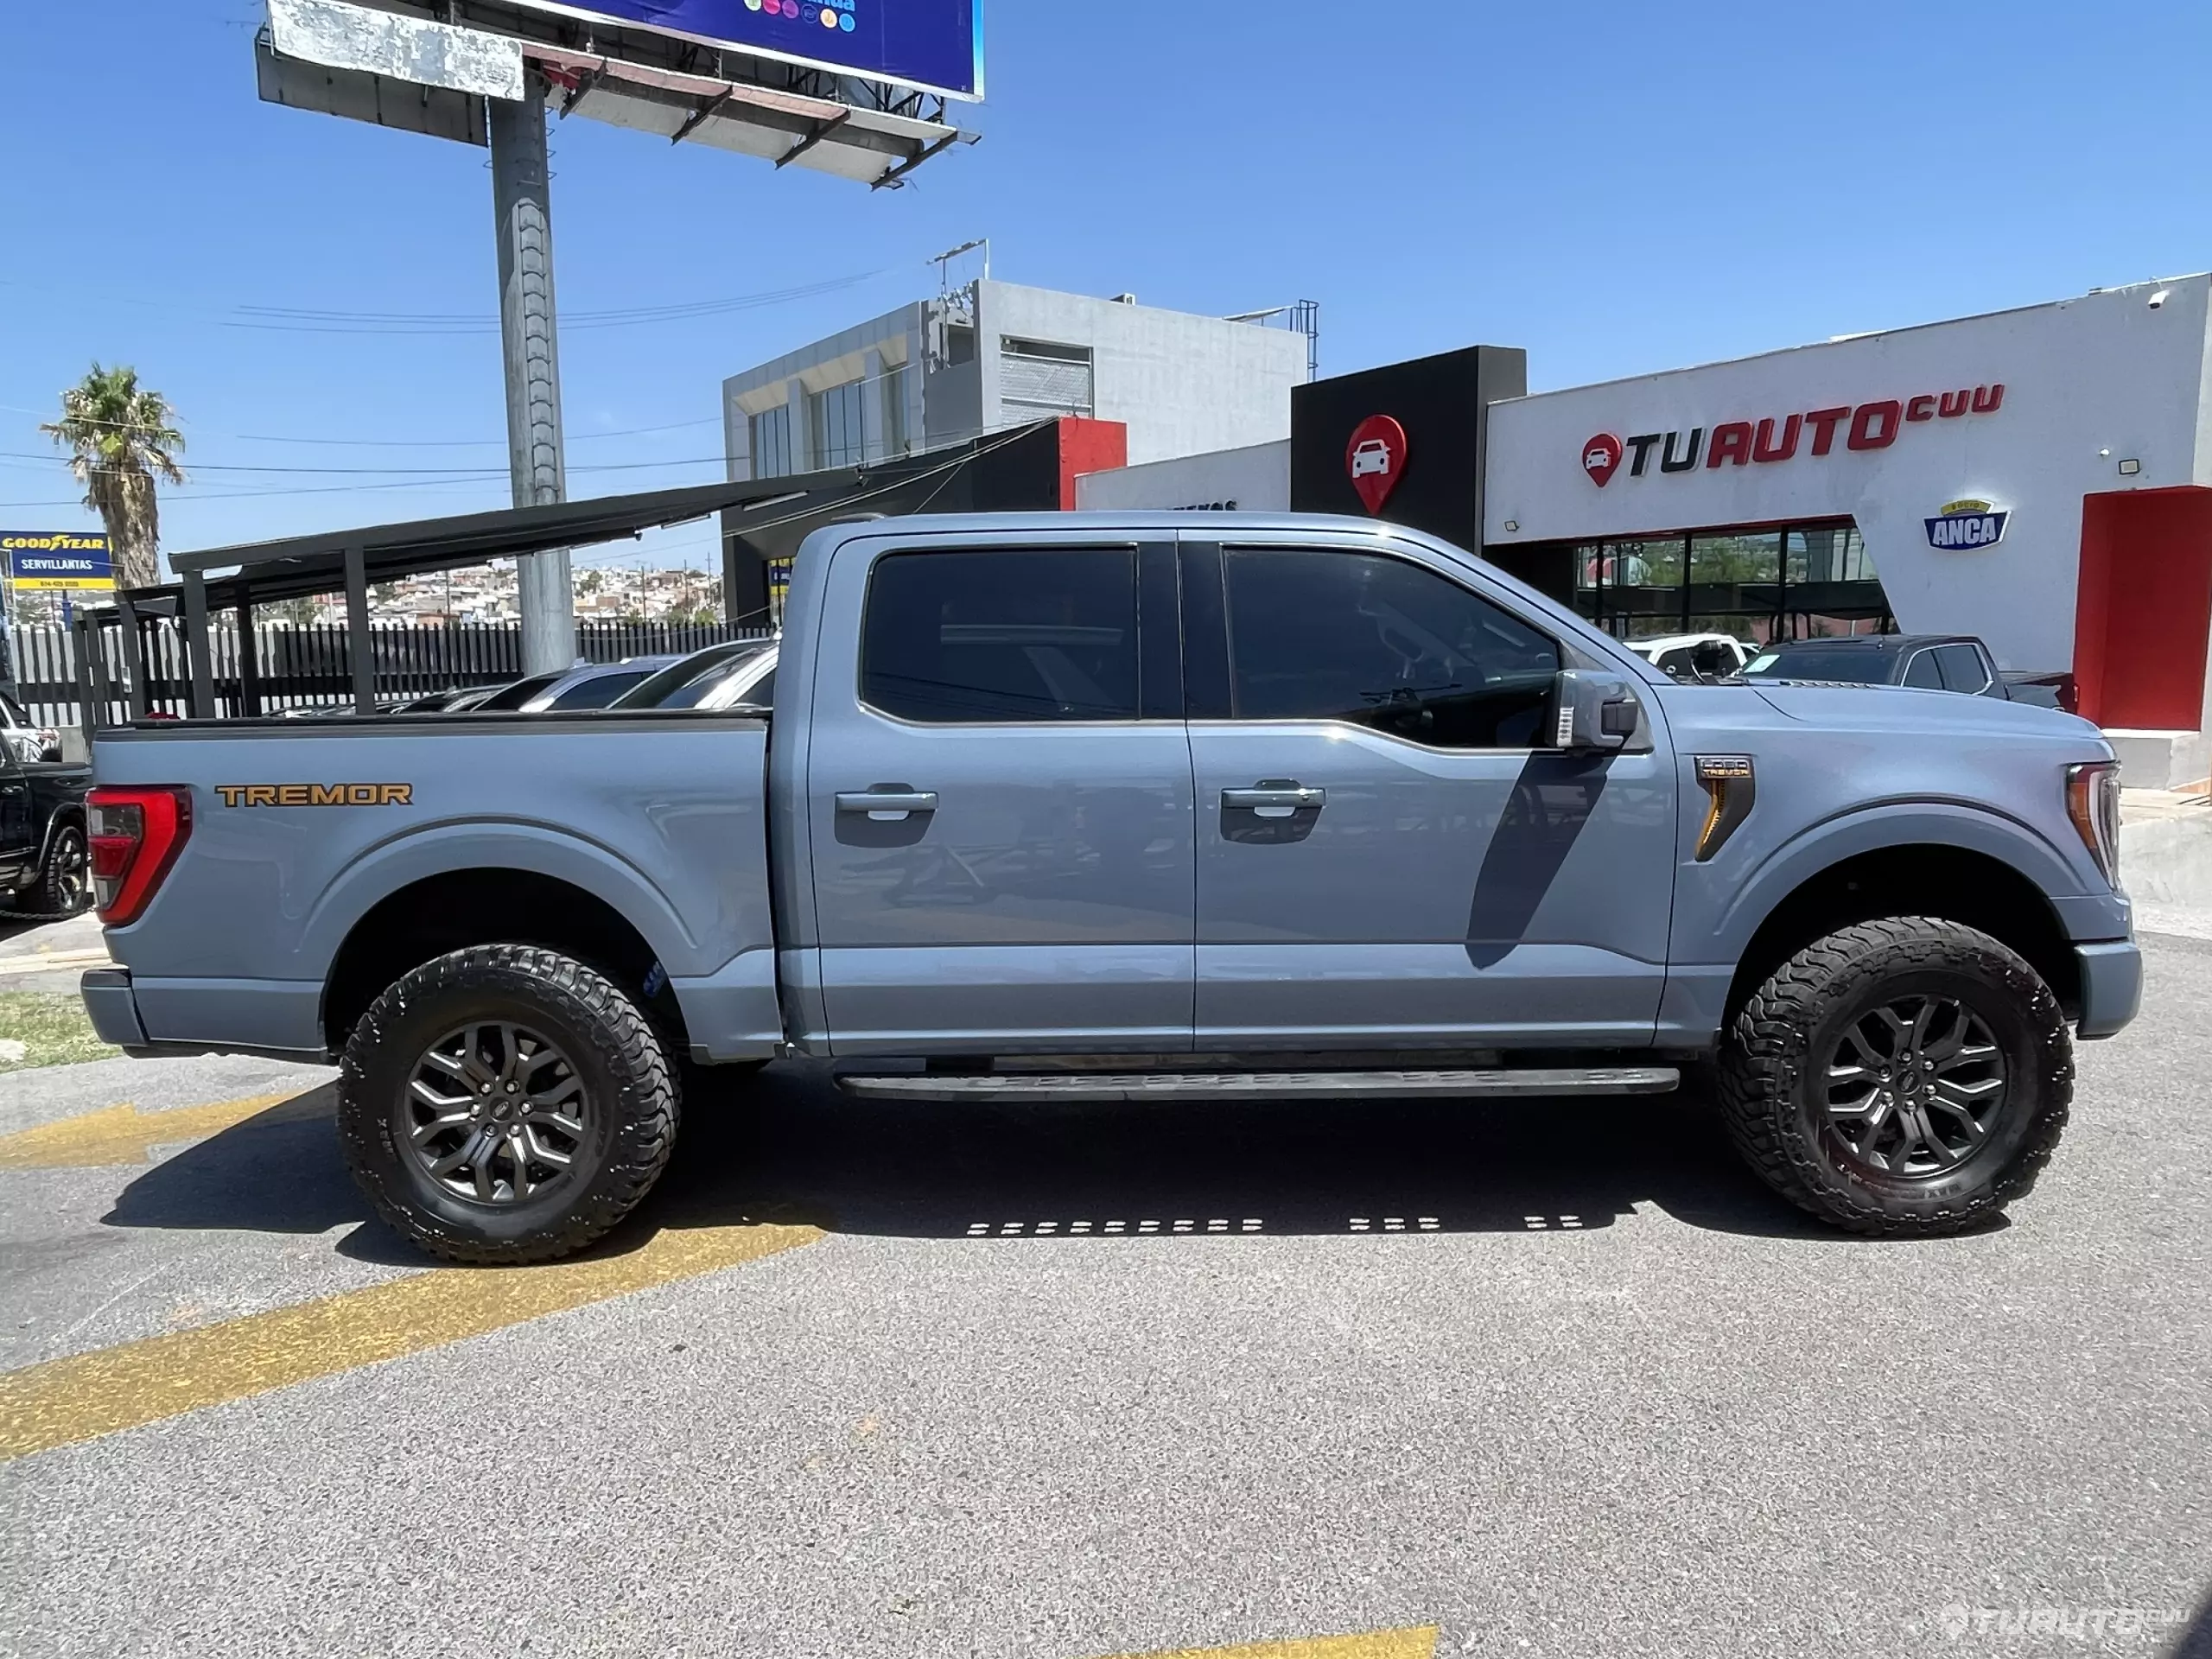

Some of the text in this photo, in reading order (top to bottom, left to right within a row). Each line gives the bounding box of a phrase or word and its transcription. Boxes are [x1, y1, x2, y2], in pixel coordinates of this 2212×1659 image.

[1932, 517, 1997, 546] ANCA
[2, 534, 105, 551] GOODYEAR
[21, 559, 93, 570] SERVILLANTAS
[214, 783, 414, 808] TREMOR
